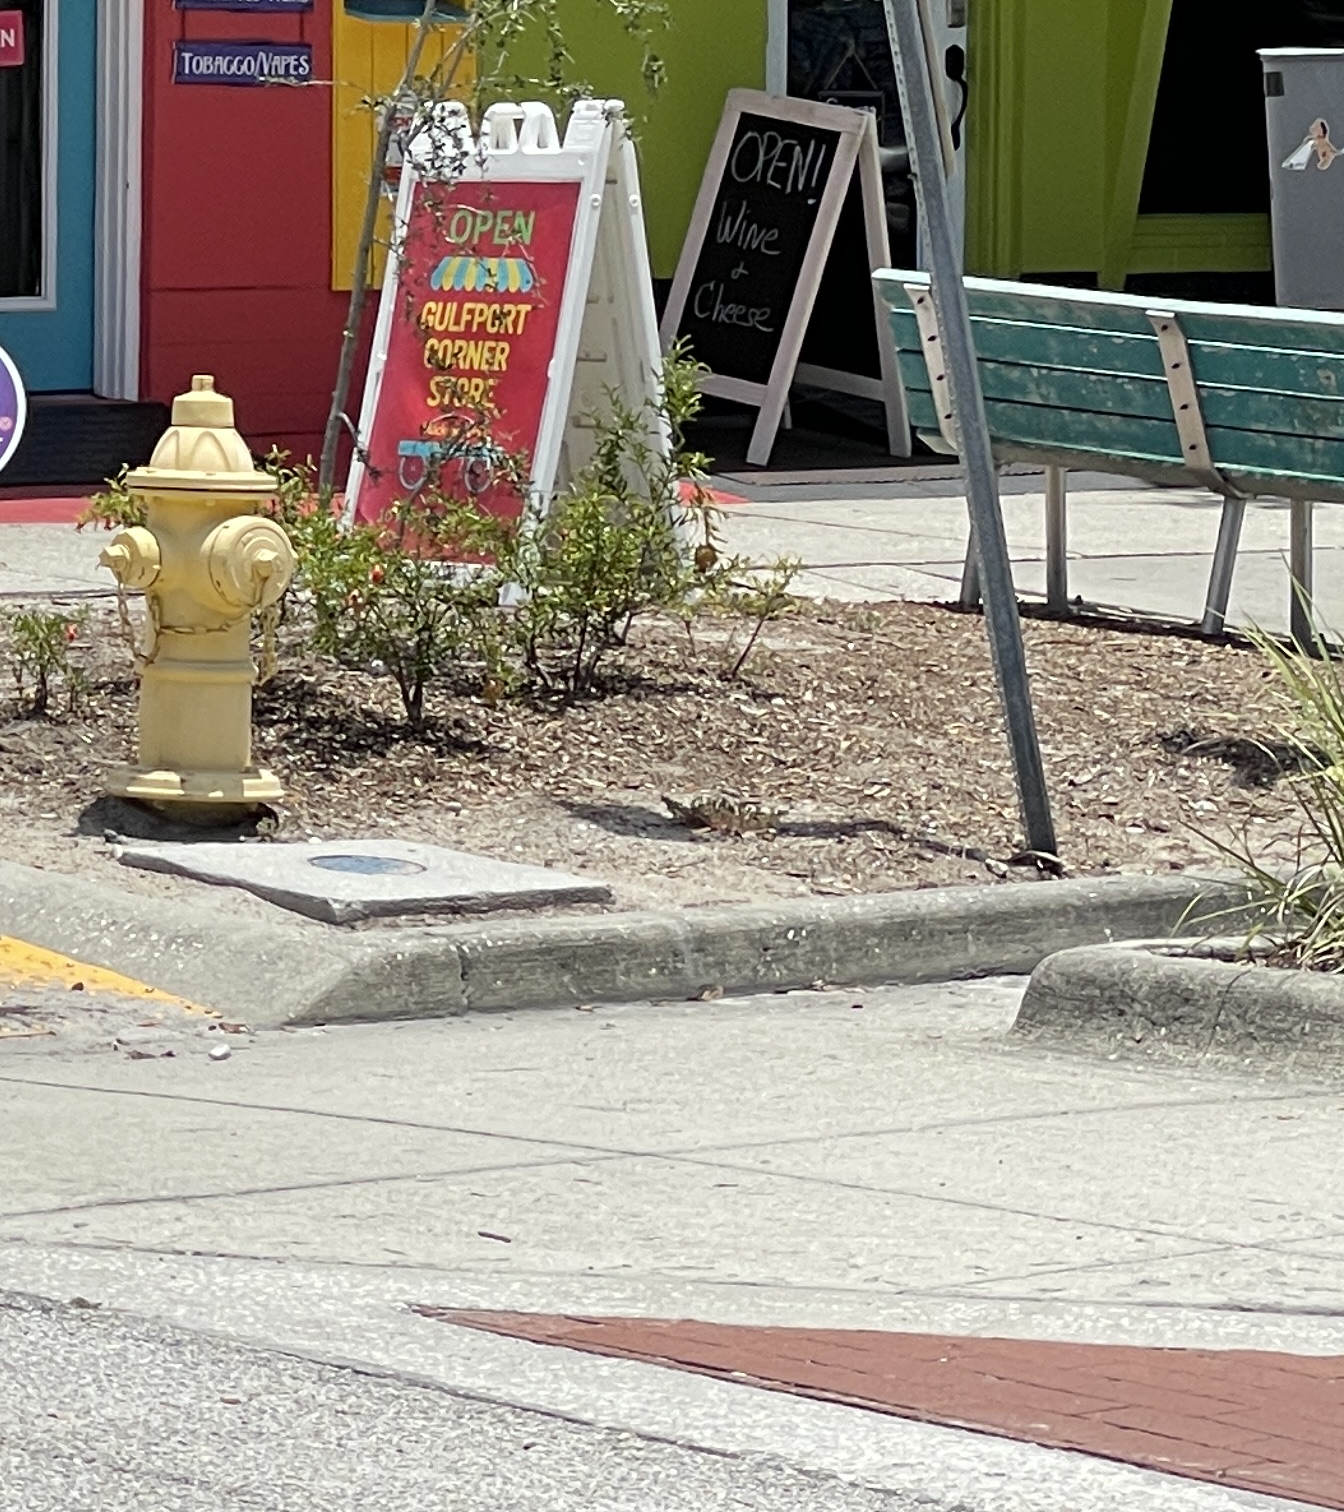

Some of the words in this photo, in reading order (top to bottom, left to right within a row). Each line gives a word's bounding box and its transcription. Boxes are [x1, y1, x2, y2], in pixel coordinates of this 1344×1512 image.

[731, 130, 826, 205] OPEN!
[449, 209, 536, 246] OPEN
[420, 300, 533, 335] GULFPORT
[694, 280, 774, 333] Cheese
[424, 337, 511, 371] CORNER
